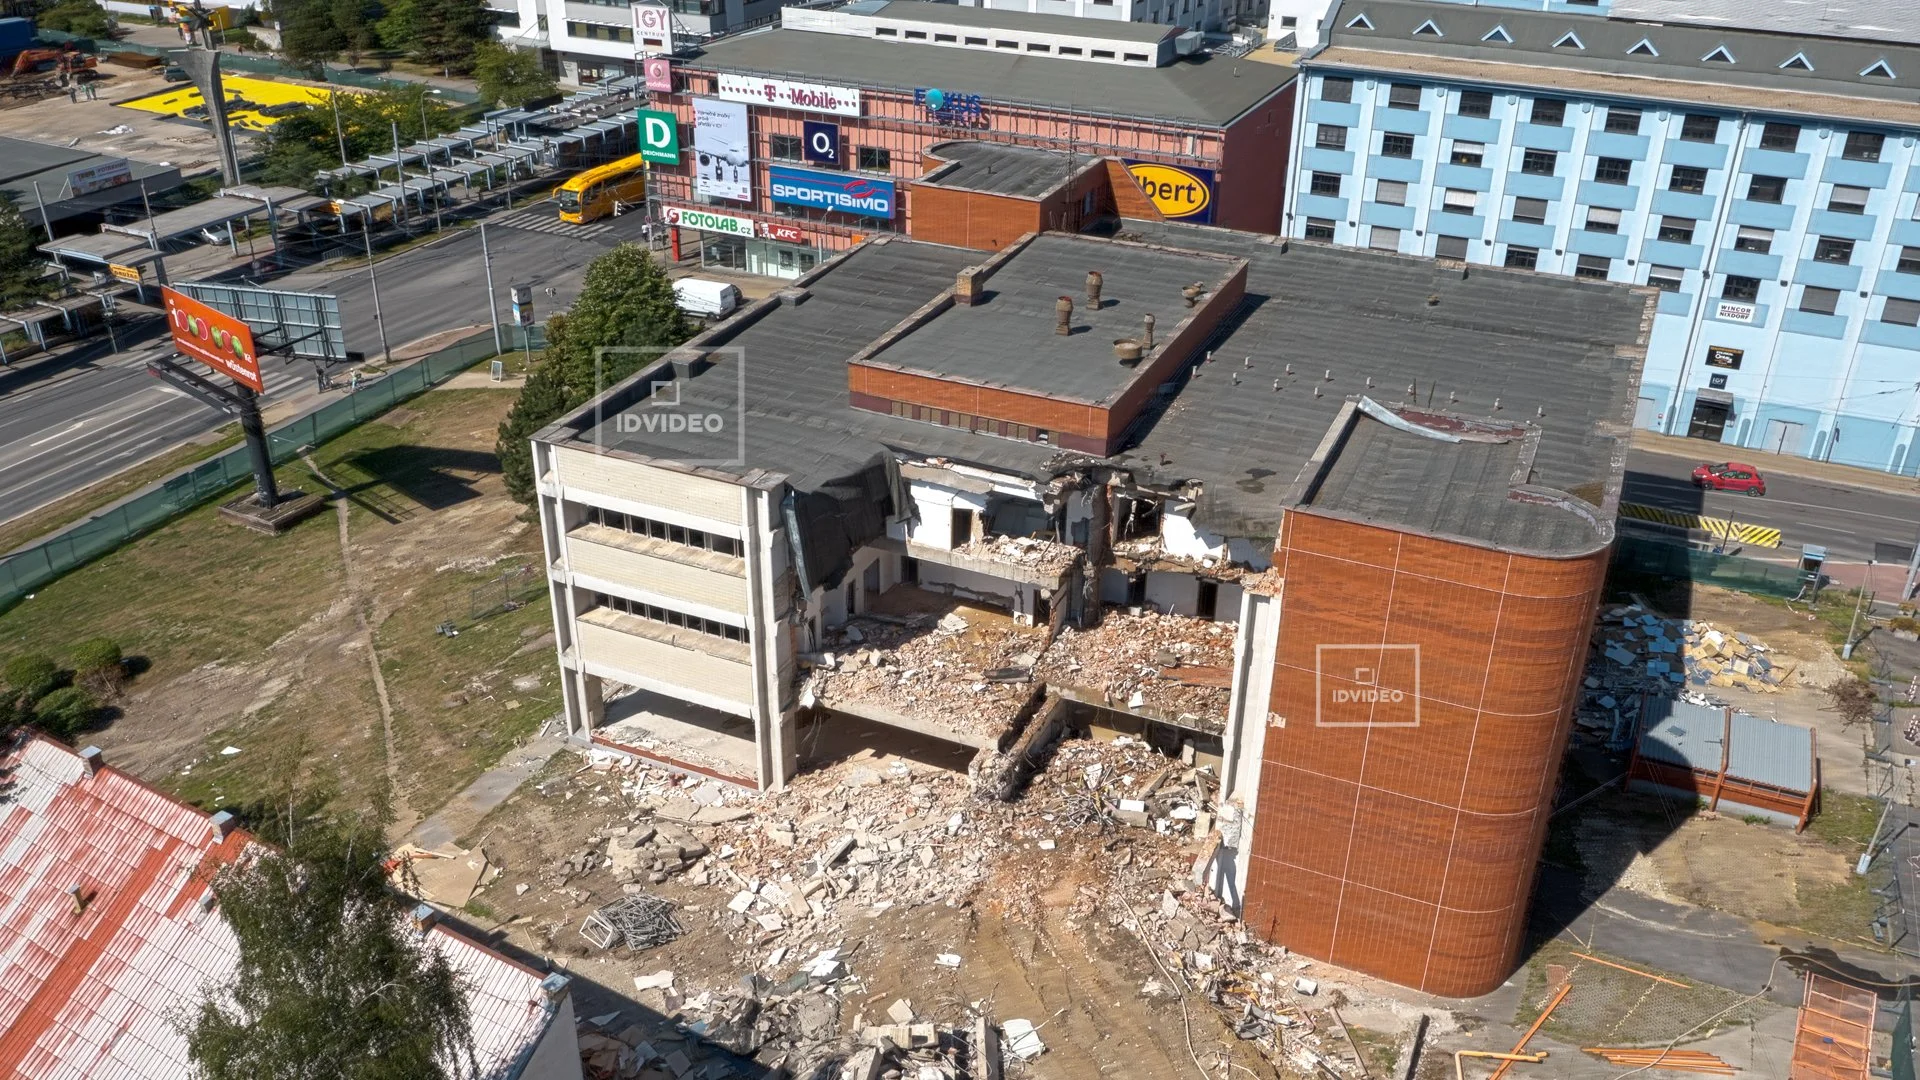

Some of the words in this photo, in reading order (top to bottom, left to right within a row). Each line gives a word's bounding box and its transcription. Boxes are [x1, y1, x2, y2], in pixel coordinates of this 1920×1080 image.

[635, 7, 667, 31] IGY
[636, 30, 665, 38] CENTRUM
[914, 88, 981, 114] FKUS
[642, 149, 676, 159] DEICHMANN
[772, 183, 889, 213] SPORTISIMO
[776, 228, 798, 239] KFC
[1721, 305, 1751, 314] WINCOR
[1719, 312, 1750, 320] NIXDORF
